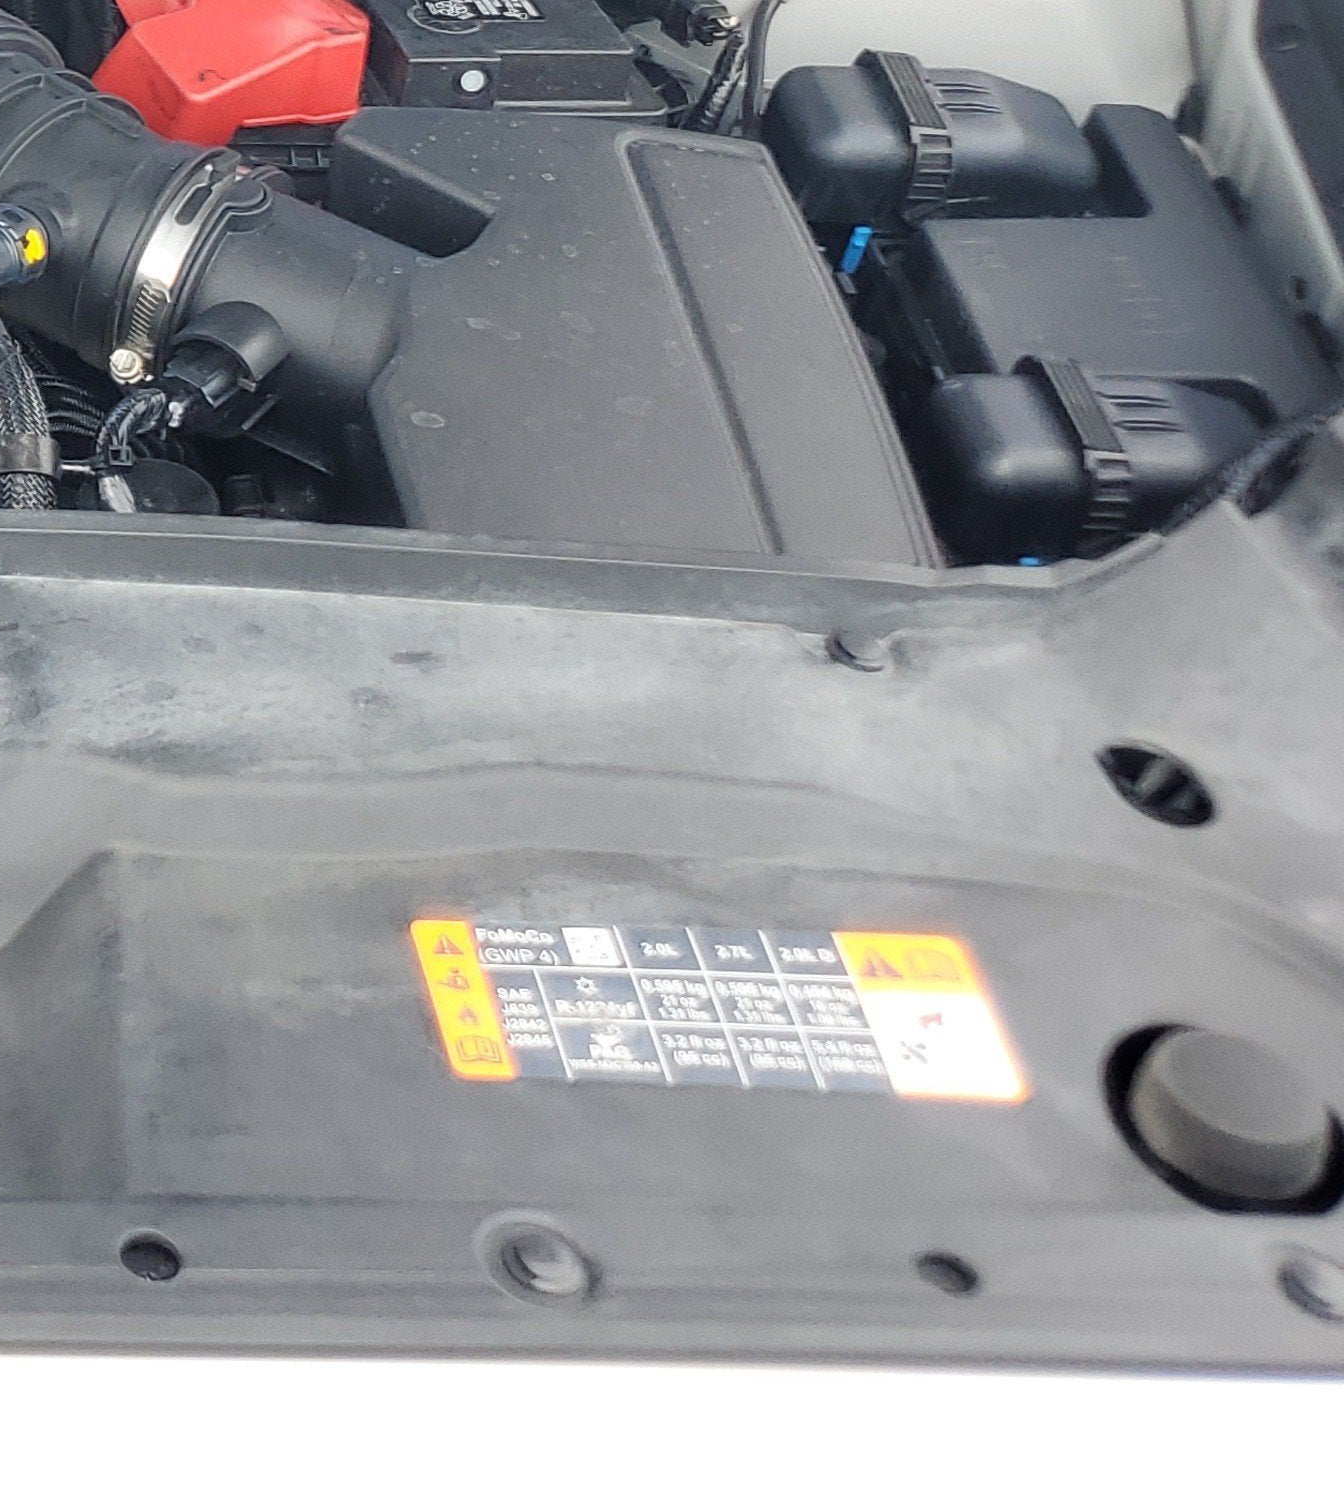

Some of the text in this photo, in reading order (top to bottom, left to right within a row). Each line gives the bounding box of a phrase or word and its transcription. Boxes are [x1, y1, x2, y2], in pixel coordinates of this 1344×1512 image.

[475, 927, 555, 943] FoMoCo
[479, 948, 561, 966] (GWP 4)
[640, 942, 680, 957] 2.0L
[497, 988, 533, 1000] SAE
